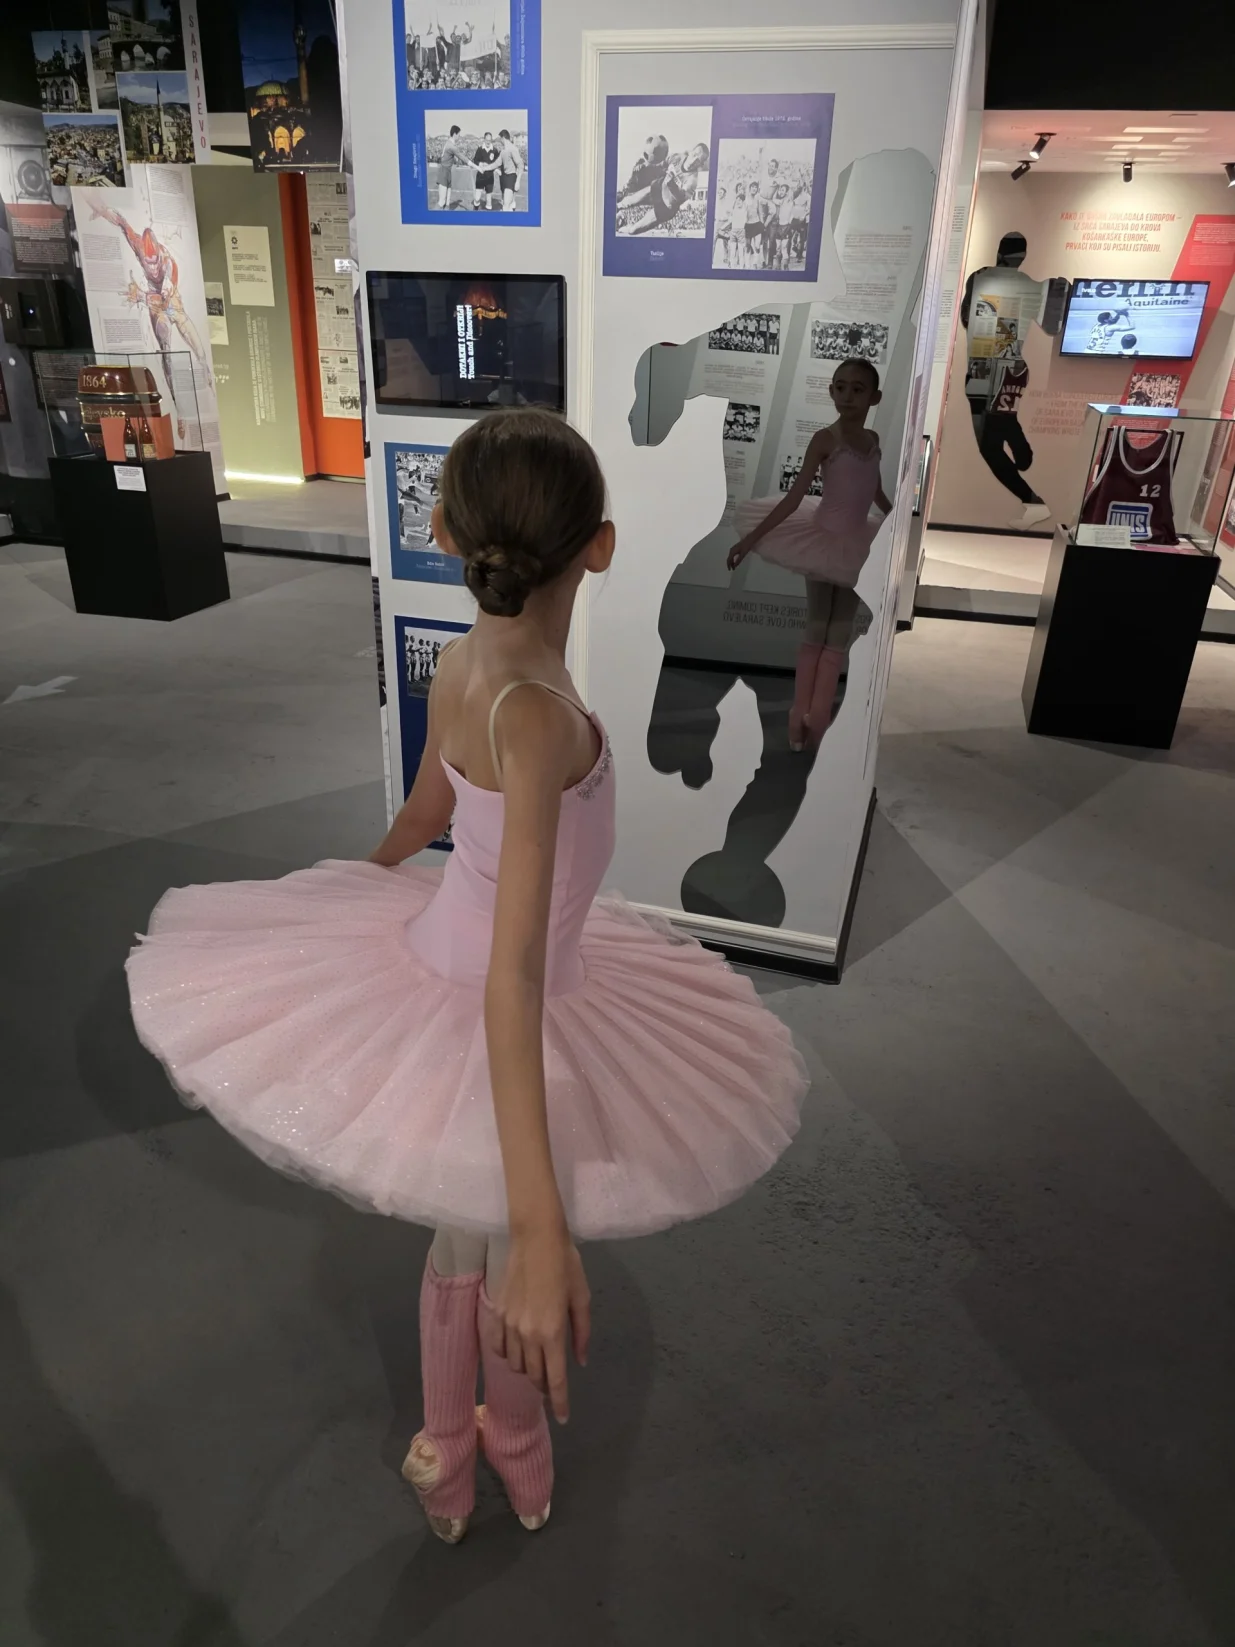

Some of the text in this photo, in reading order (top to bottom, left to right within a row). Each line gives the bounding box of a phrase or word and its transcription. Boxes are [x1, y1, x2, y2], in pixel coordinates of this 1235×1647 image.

[188, 14, 207, 149] SARAJEVO
[1060, 212, 1077, 220] KAKO
[1145, 213, 1176, 222] EUROPOM
[1130, 223, 1140, 231] DO
[1140, 223, 1161, 232] KROVA
[1065, 242, 1088, 251] PRVACI
[1103, 243, 1112, 251] SU
[1112, 243, 1133, 252] PISALI
[1125, 297, 1189, 307] Aquitaine
[83, 374, 107, 388] 1864
[1139, 484, 1161, 498] 12
[1111, 512, 1146, 533] UNIS
